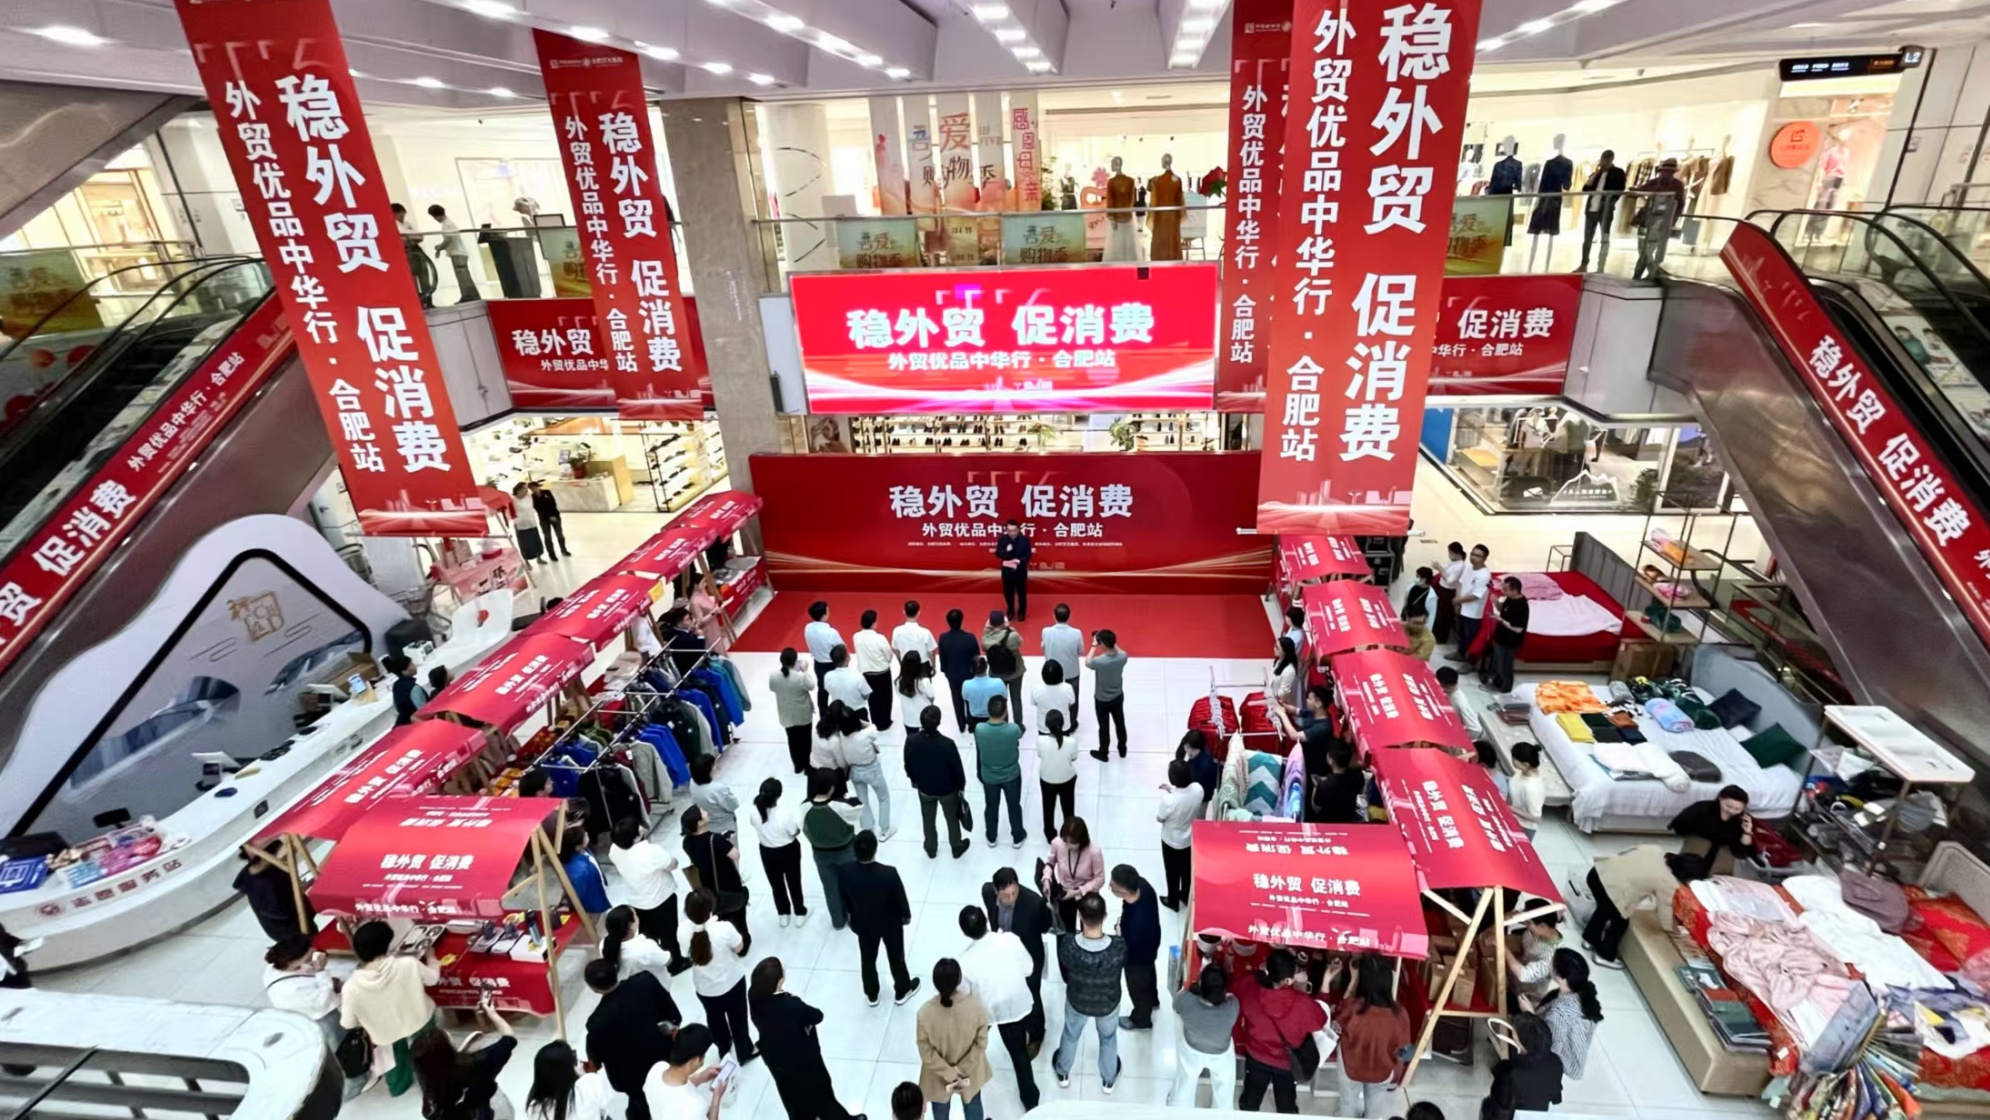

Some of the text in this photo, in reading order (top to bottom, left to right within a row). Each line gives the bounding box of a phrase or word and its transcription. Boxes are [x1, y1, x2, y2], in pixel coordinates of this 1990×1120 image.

[1904, 51, 1922, 64] L2
[598, 112, 682, 373] 稳外贸 促消费
[1339, 3, 1453, 462] 稳外贸 促消费
[274, 74, 451, 473] 稳外贸 促消费
[511, 328, 594, 357] 稳外贸
[846, 302, 1155, 349] 稳外贸 促消费
[1457, 308, 1555, 339] 促消费
[1809, 334, 1971, 547] 稳外贸 促消费
[889, 484, 1133, 518] 稳外贸 促消费
[32, 479, 136, 576] 促消费
[922, 522, 1104, 538] 外贸优品中行·合肥站
[1253, 873, 1361, 896] 稳外贸 促消费
